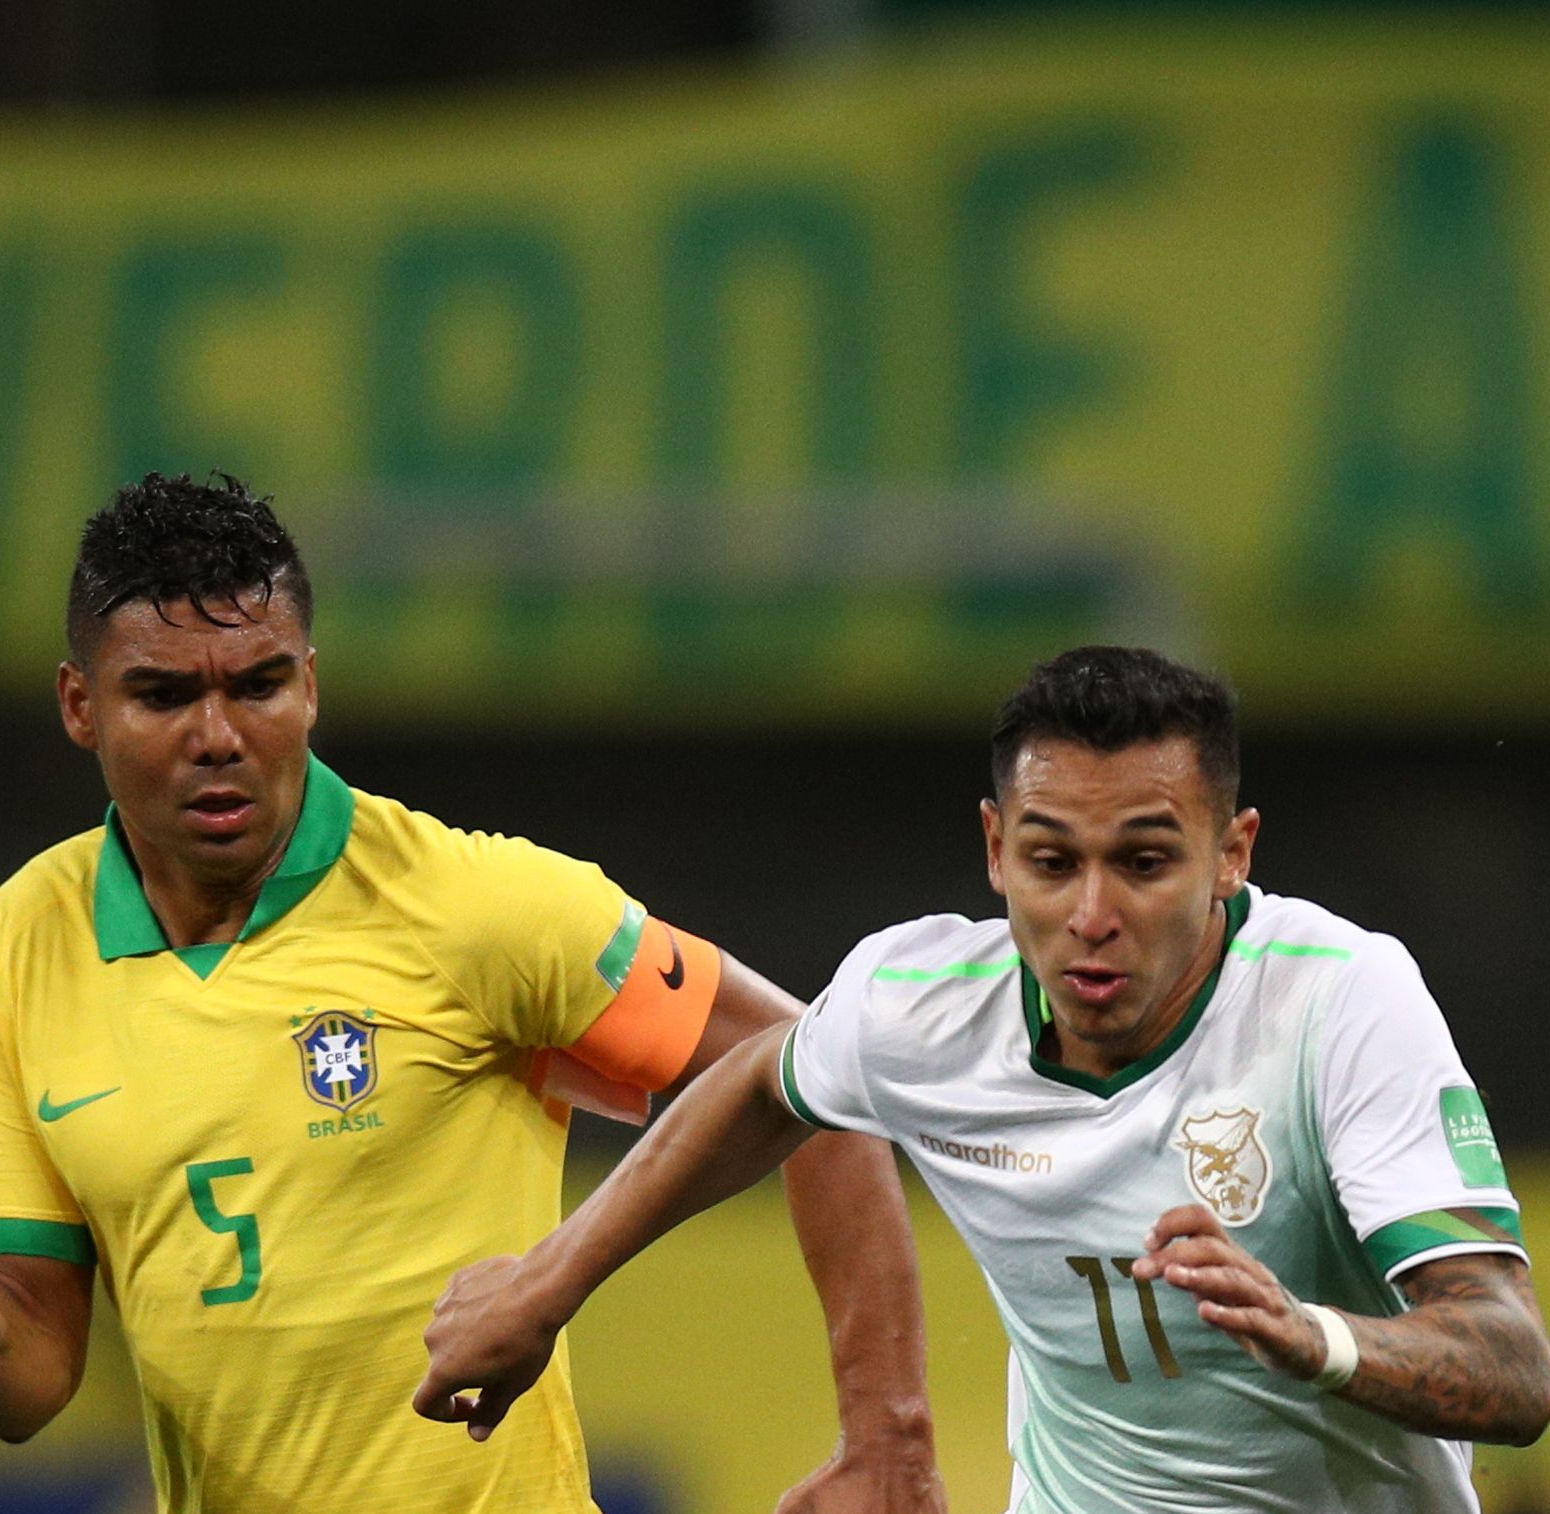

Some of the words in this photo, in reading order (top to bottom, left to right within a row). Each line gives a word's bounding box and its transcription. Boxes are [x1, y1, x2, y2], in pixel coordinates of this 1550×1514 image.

[325, 1051, 352, 1065] CBF
[308, 1111, 385, 1139] BRASIL
[919, 1132, 1053, 1174] marathon
[186, 1156, 262, 1307] 5
[1065, 1255, 1182, 1384] 11
